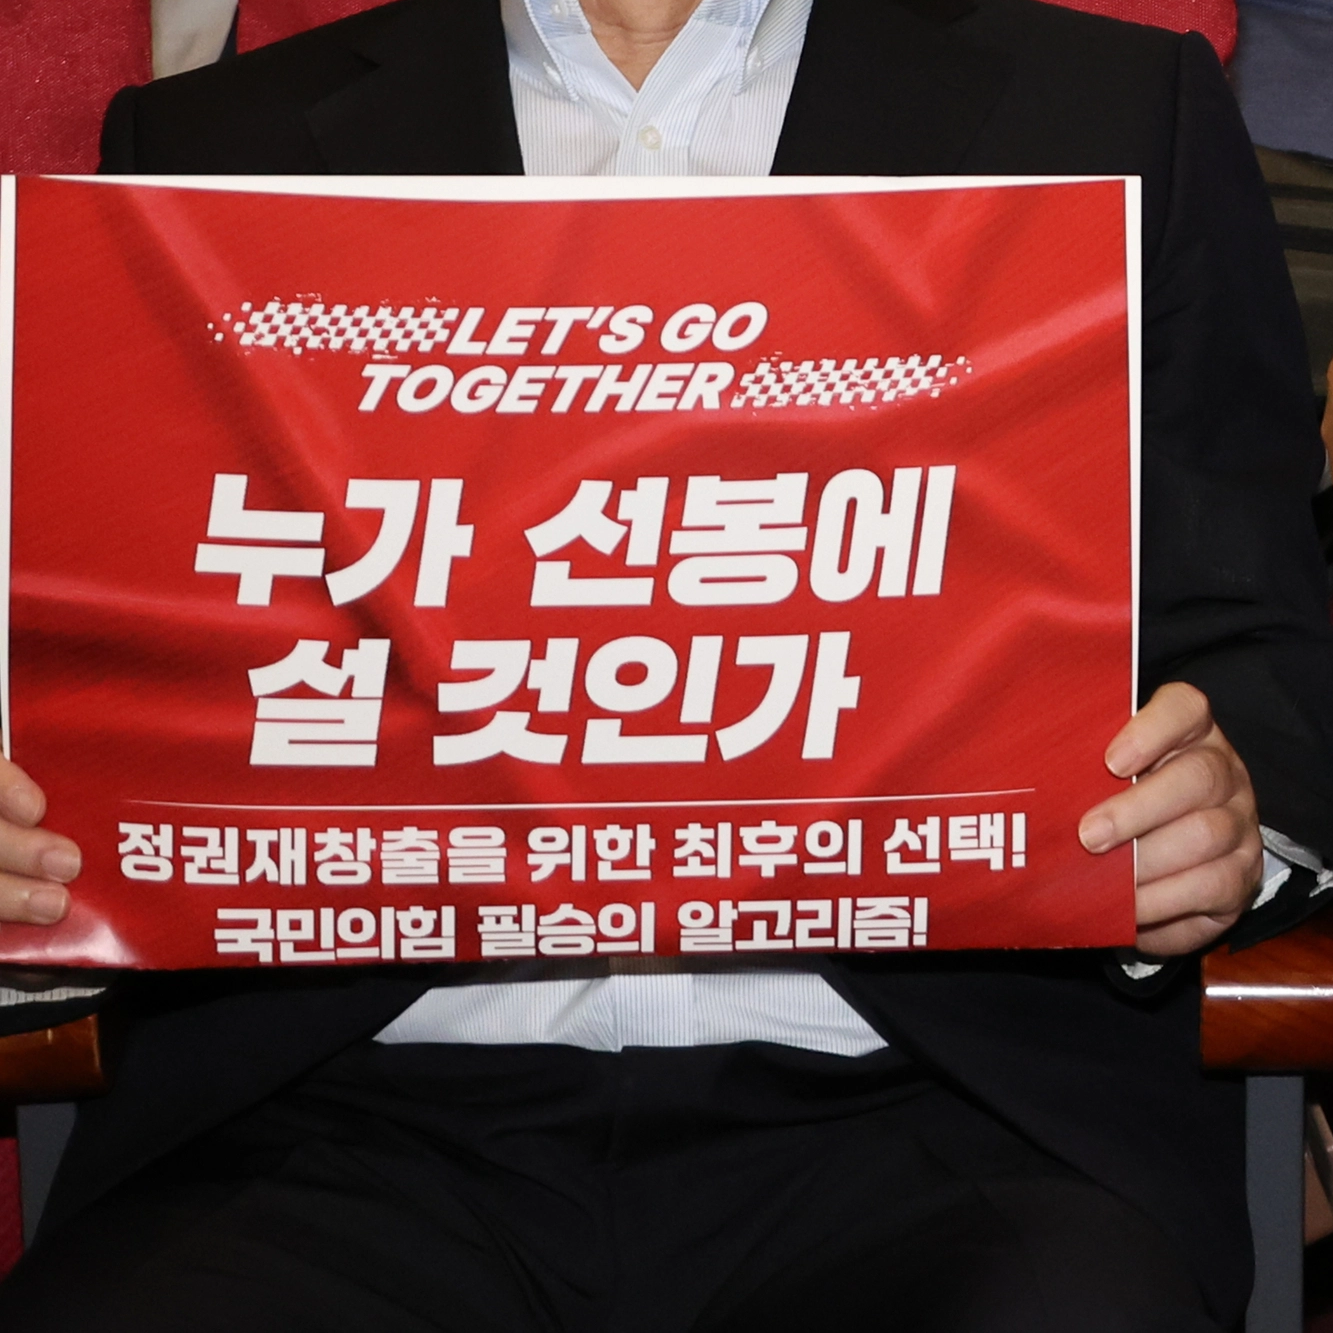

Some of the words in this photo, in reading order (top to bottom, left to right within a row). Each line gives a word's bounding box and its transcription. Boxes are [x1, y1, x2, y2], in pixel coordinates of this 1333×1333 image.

[446, 305, 652, 355] LET'S
[660, 301, 768, 353] GO
[358, 362, 733, 414] TOGETHER
[194, 473, 474, 607] 누가
[524, 464, 957, 607] 선봉에
[247, 638, 391, 767] 설
[433, 631, 861, 766] 것인가
[118, 822, 507, 885] 정권재창출을
[527, 823, 656, 882] 위한
[673, 819, 862, 879] 최후의
[883, 812, 1026, 874] 선택!
[214, 905, 456, 963] 국민의힘
[477, 901, 655, 957] 필승의
[677, 896, 928, 952] 알고리즘!
